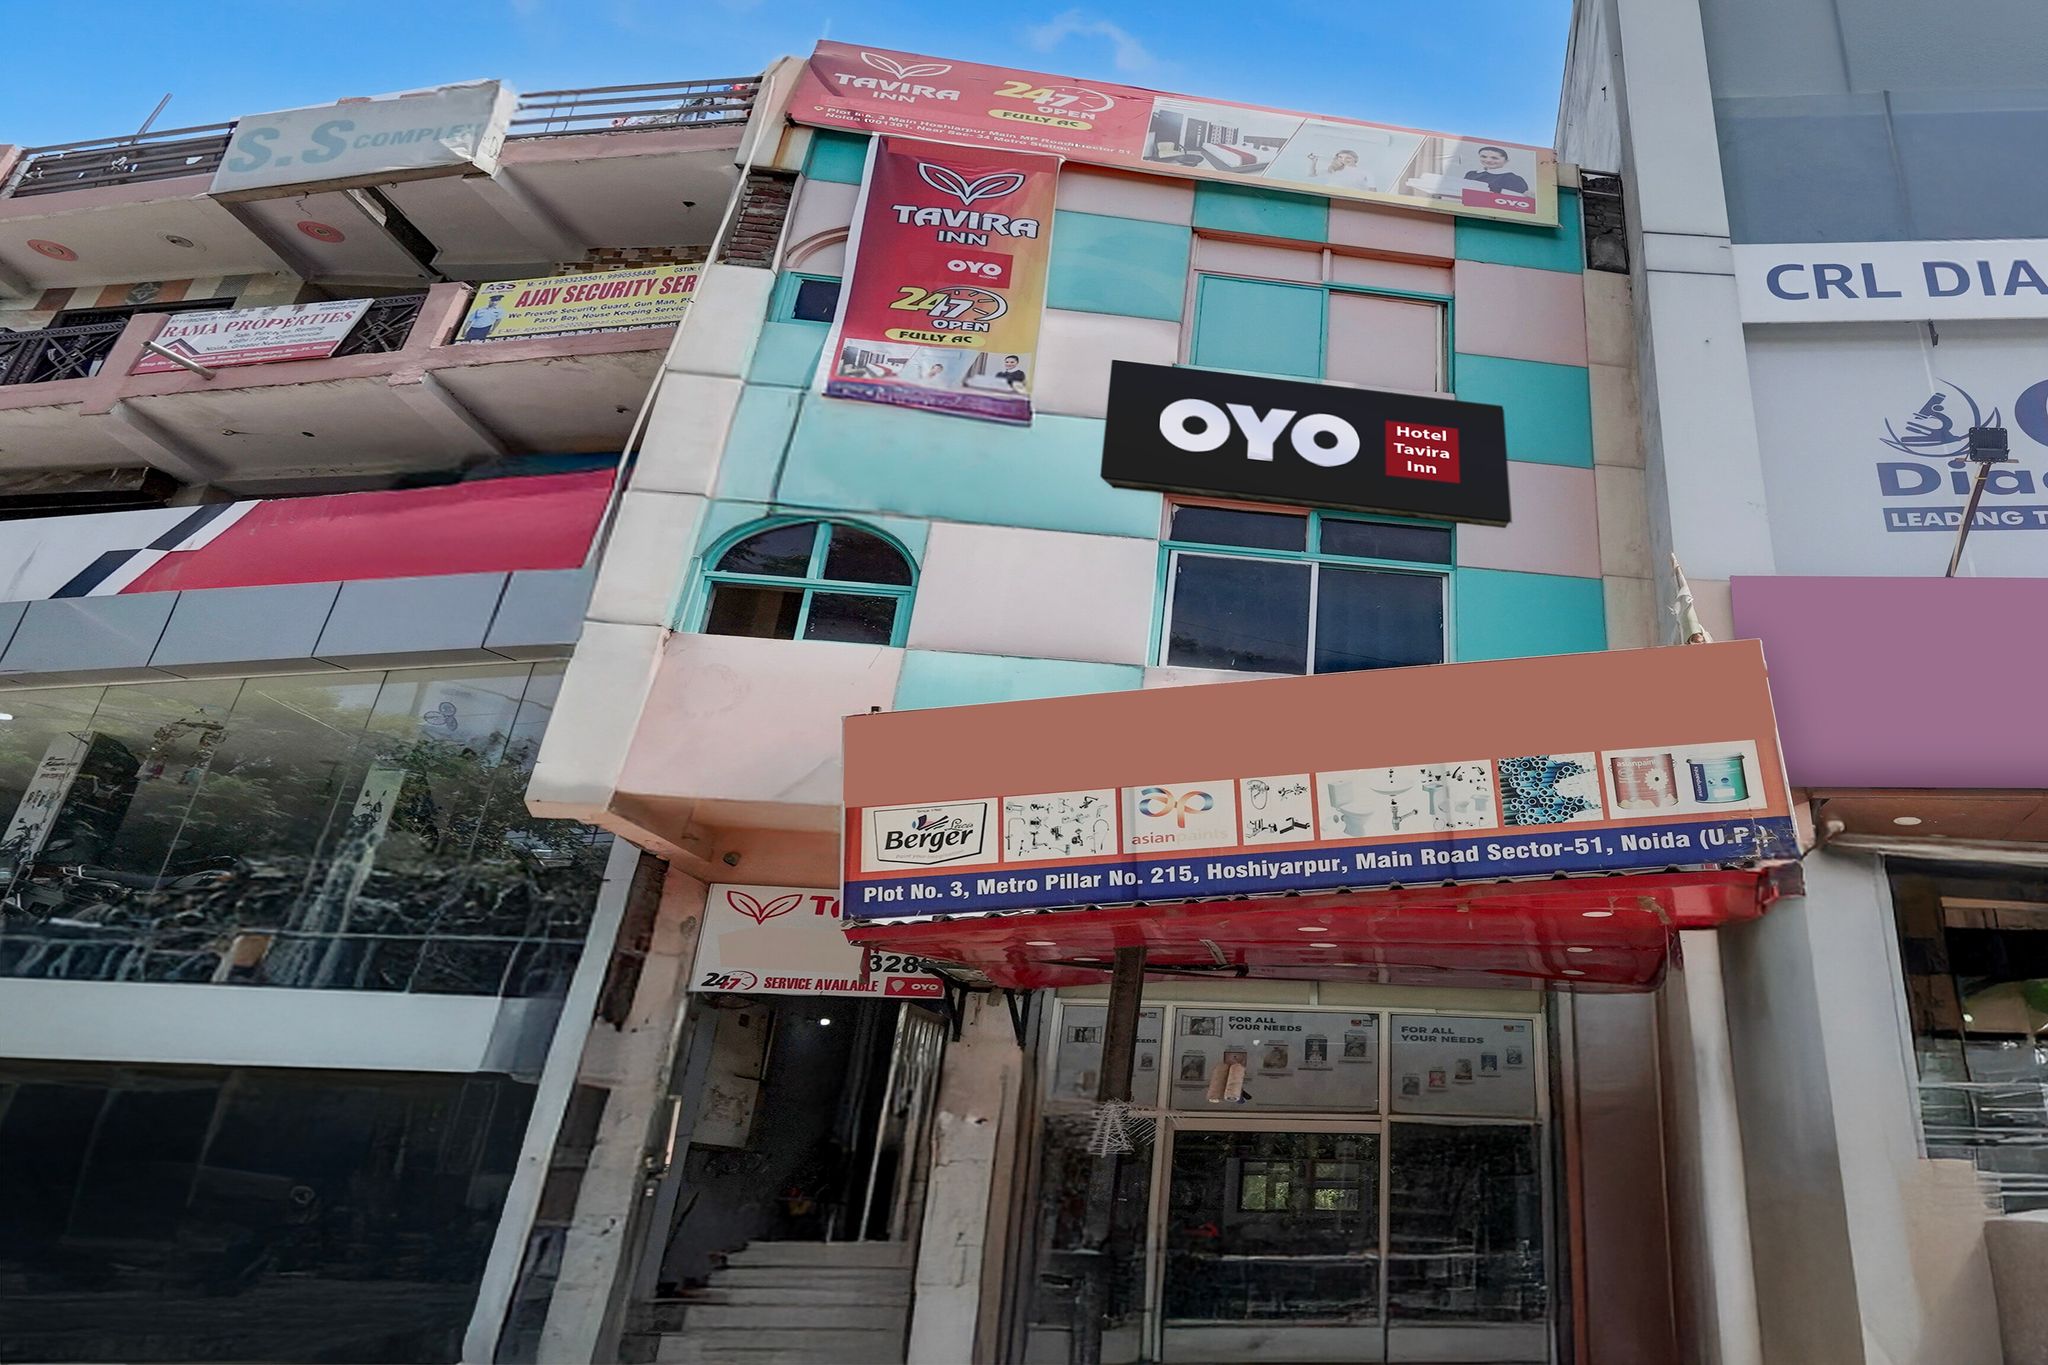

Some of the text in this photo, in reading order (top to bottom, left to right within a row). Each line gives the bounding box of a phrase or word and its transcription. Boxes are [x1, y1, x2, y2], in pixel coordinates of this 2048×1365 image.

[834, 73, 961, 101] TAVIRA
[872, 90, 916, 104] INN
[1001, 110, 1052, 126] FULLY
[1037, 106, 1097, 120] OPEN
[825, 113, 861, 122] Noida
[993, 137, 1028, 146] Metro
[826, 107, 851, 116] Plot
[888, 116, 917, 125] Main
[988, 130, 1017, 139] Main
[228, 119, 354, 173] S.S
[1494, 198, 1530, 208] OYO
[892, 204, 1040, 239] TAVIRA
[937, 230, 988, 246] INN
[947, 259, 1002, 276] OYO
[1766, 263, 1903, 300] CRL
[514, 274, 698, 308] AJAY SECURITY SER
[524, 310, 558, 318] Provide
[560, 305, 598, 315] Security
[600, 302, 631, 311] Guard,
[655, 298, 678, 306] Man,
[534, 316, 558, 324] Party
[560, 314, 580, 323] Boy,
[582, 311, 611, 319] House
[613, 307, 651, 317] Keeping
[161, 322, 218, 338] RAMA
[224, 309, 356, 334] PROPERTIES
[932, 319, 990, 332] OPEN
[899, 330, 973, 344] FULLY AC
[1159, 398, 1361, 468] OYO
[1396, 426, 1448, 442] Hotel
[1393, 443, 1451, 460] Tavira
[1406, 460, 1438, 475] Inn
[1876, 459, 2048, 496] Dia
[885, 829, 974, 853] Berger
[864, 885, 904, 903] Plot
[910, 883, 943, 900] No.
[950, 881, 970, 899] 3,
[977, 875, 1038, 897] Metro
[1045, 871, 1102, 892] Pillar
[1109, 869, 1144, 887] No.
[1150, 864, 1199, 885] 215,
[1207, 857, 1348, 882] Hoshiyarpur,
[1355, 850, 1412, 871] Main
[1420, 845, 1478, 866] Road
[1487, 837, 1613, 861] Sector-51,
[1621, 831, 1690, 852] Noida
[764, 976, 812, 991] SERVICE
[911, 983, 939, 992] OYO
[1228, 1016, 1252, 1024] FOR
[1228, 1023, 1261, 1031] YOUR
[1401, 1026, 1455, 1035] FOR ALL
[1401, 1034, 1485, 1044] YOUR NEEDS
